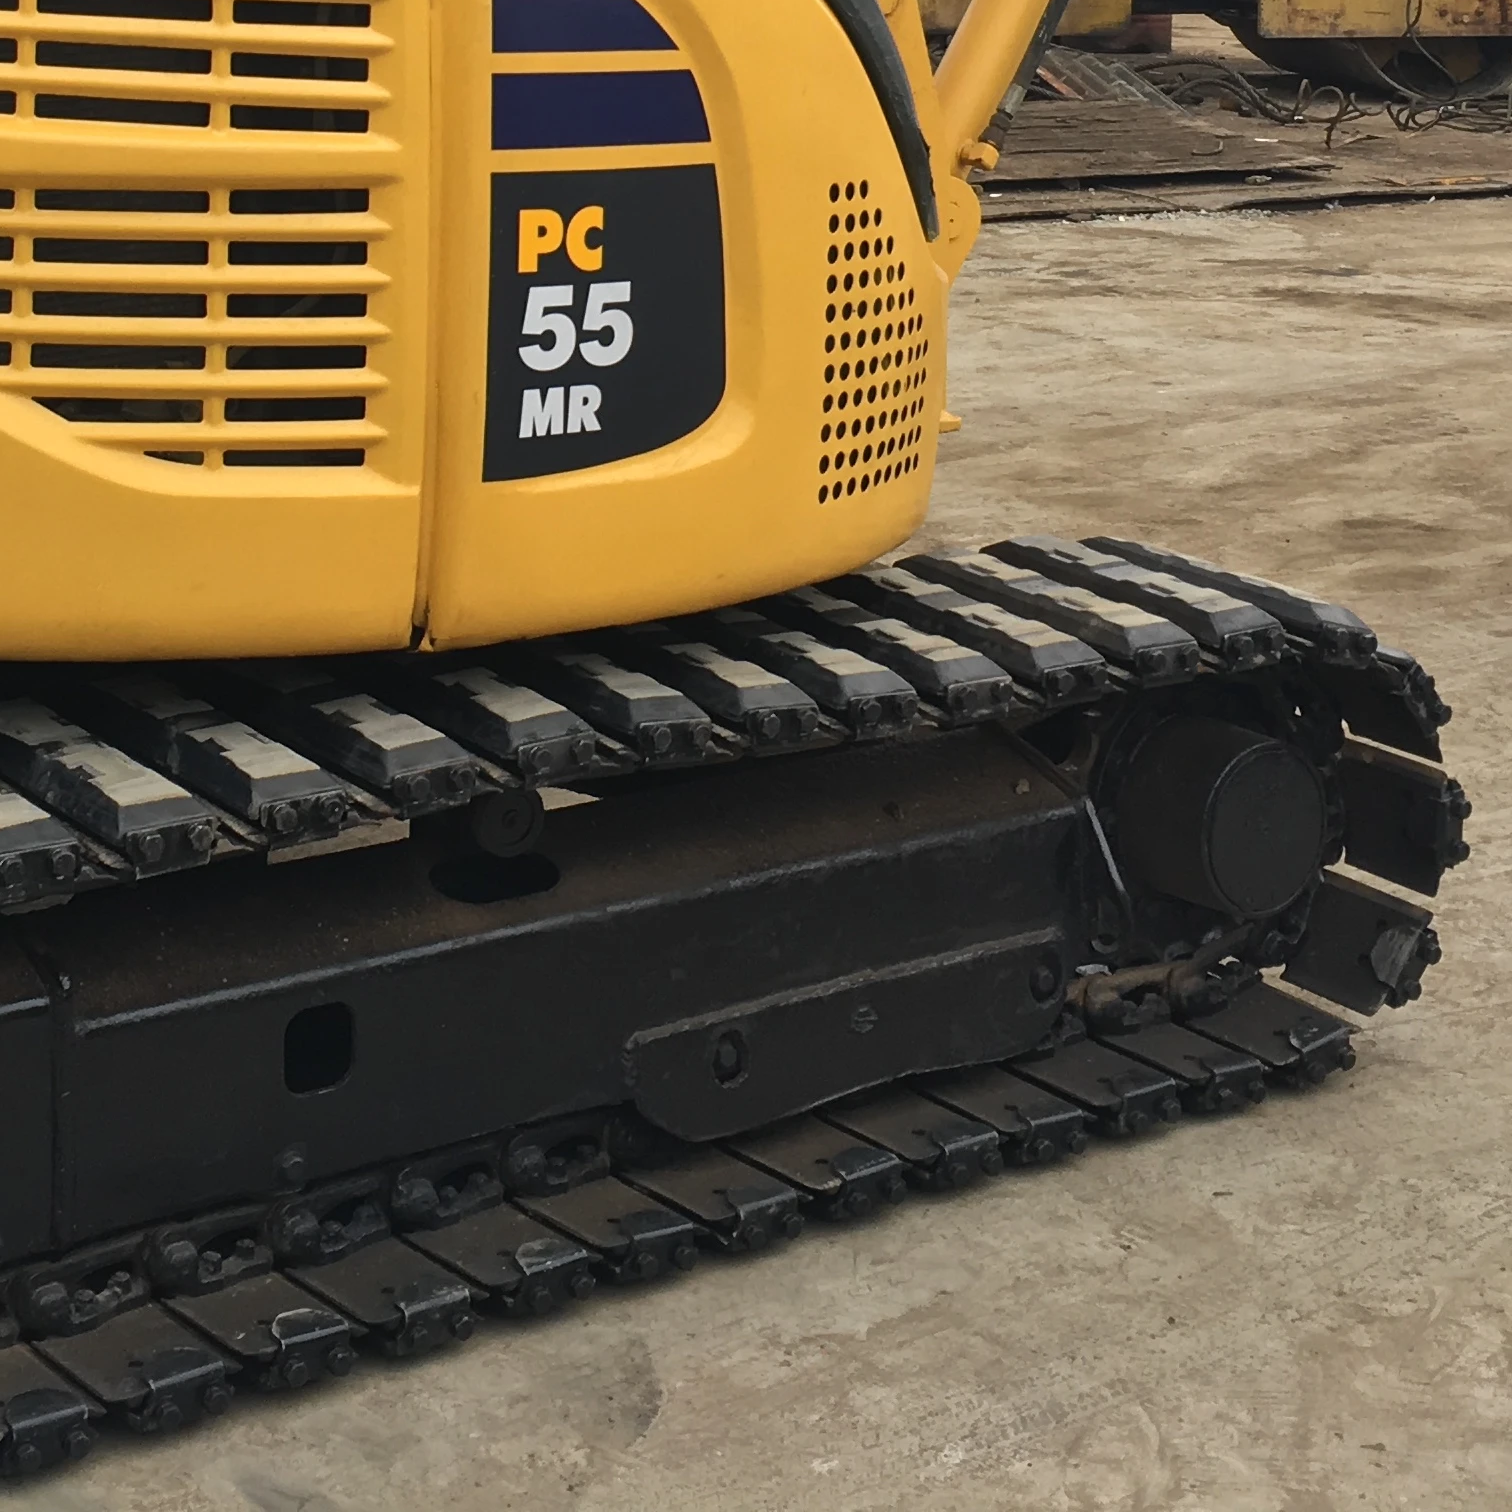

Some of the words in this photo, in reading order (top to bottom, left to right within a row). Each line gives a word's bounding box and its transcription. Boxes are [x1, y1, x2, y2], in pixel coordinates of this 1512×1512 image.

[517, 205, 604, 273] PC
[518, 280, 634, 372] 55
[518, 383, 603, 439] MR
